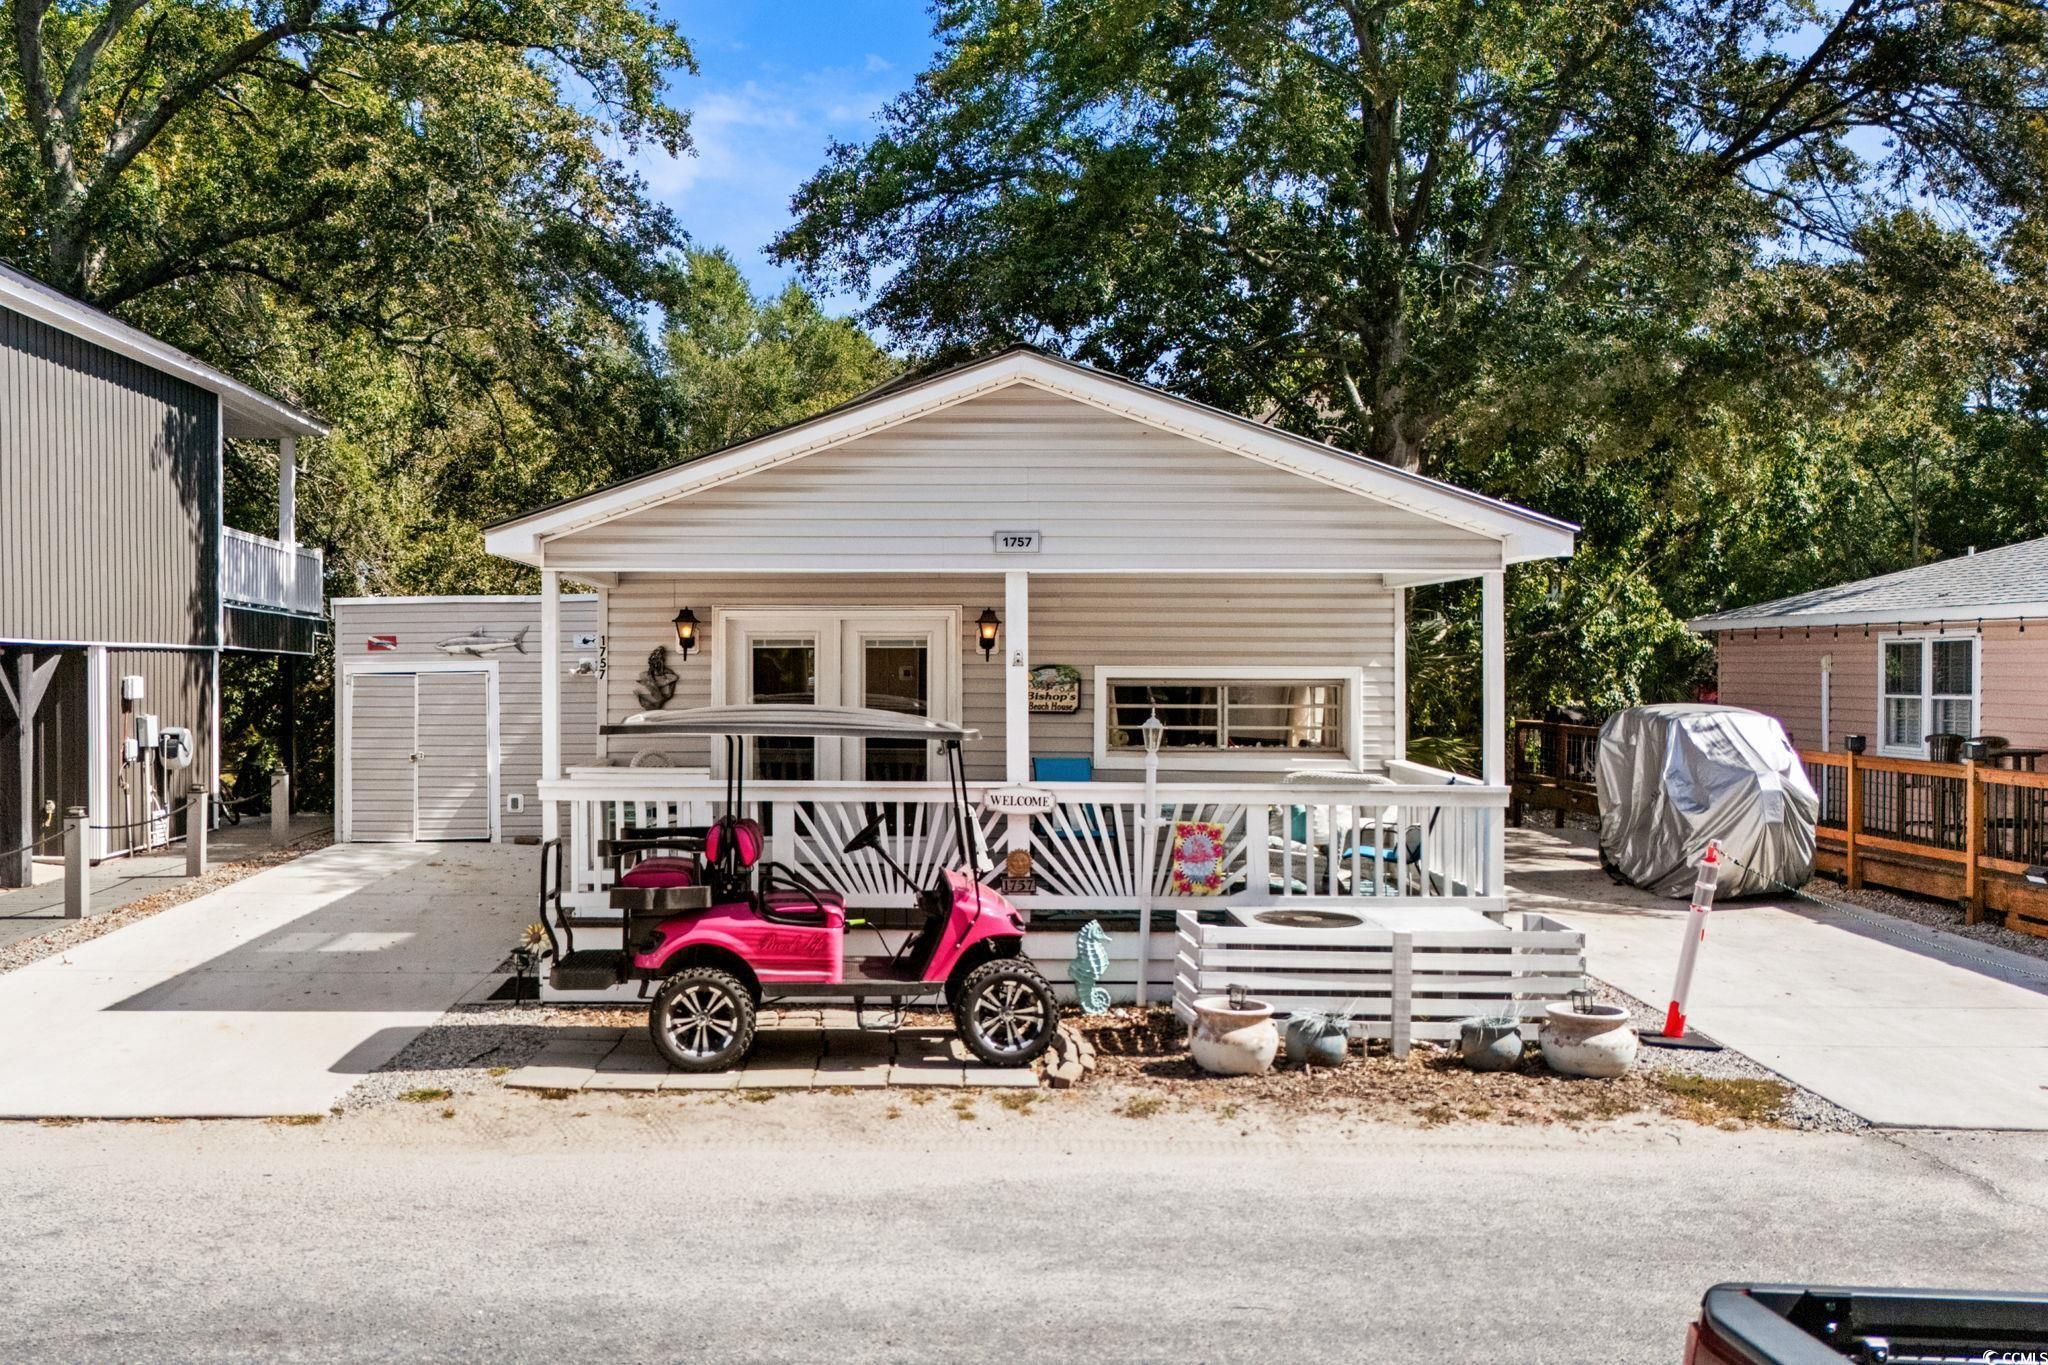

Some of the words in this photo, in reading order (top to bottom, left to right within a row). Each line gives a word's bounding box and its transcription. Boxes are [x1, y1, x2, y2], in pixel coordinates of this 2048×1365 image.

[1002, 537, 1032, 547] 1757
[1028, 691, 1076, 702] Bishop's
[1029, 702, 1049, 710] Beach
[1051, 702, 1073, 710] House
[990, 795, 1050, 807] WELCOME
[1003, 880, 1034, 891] 1757
